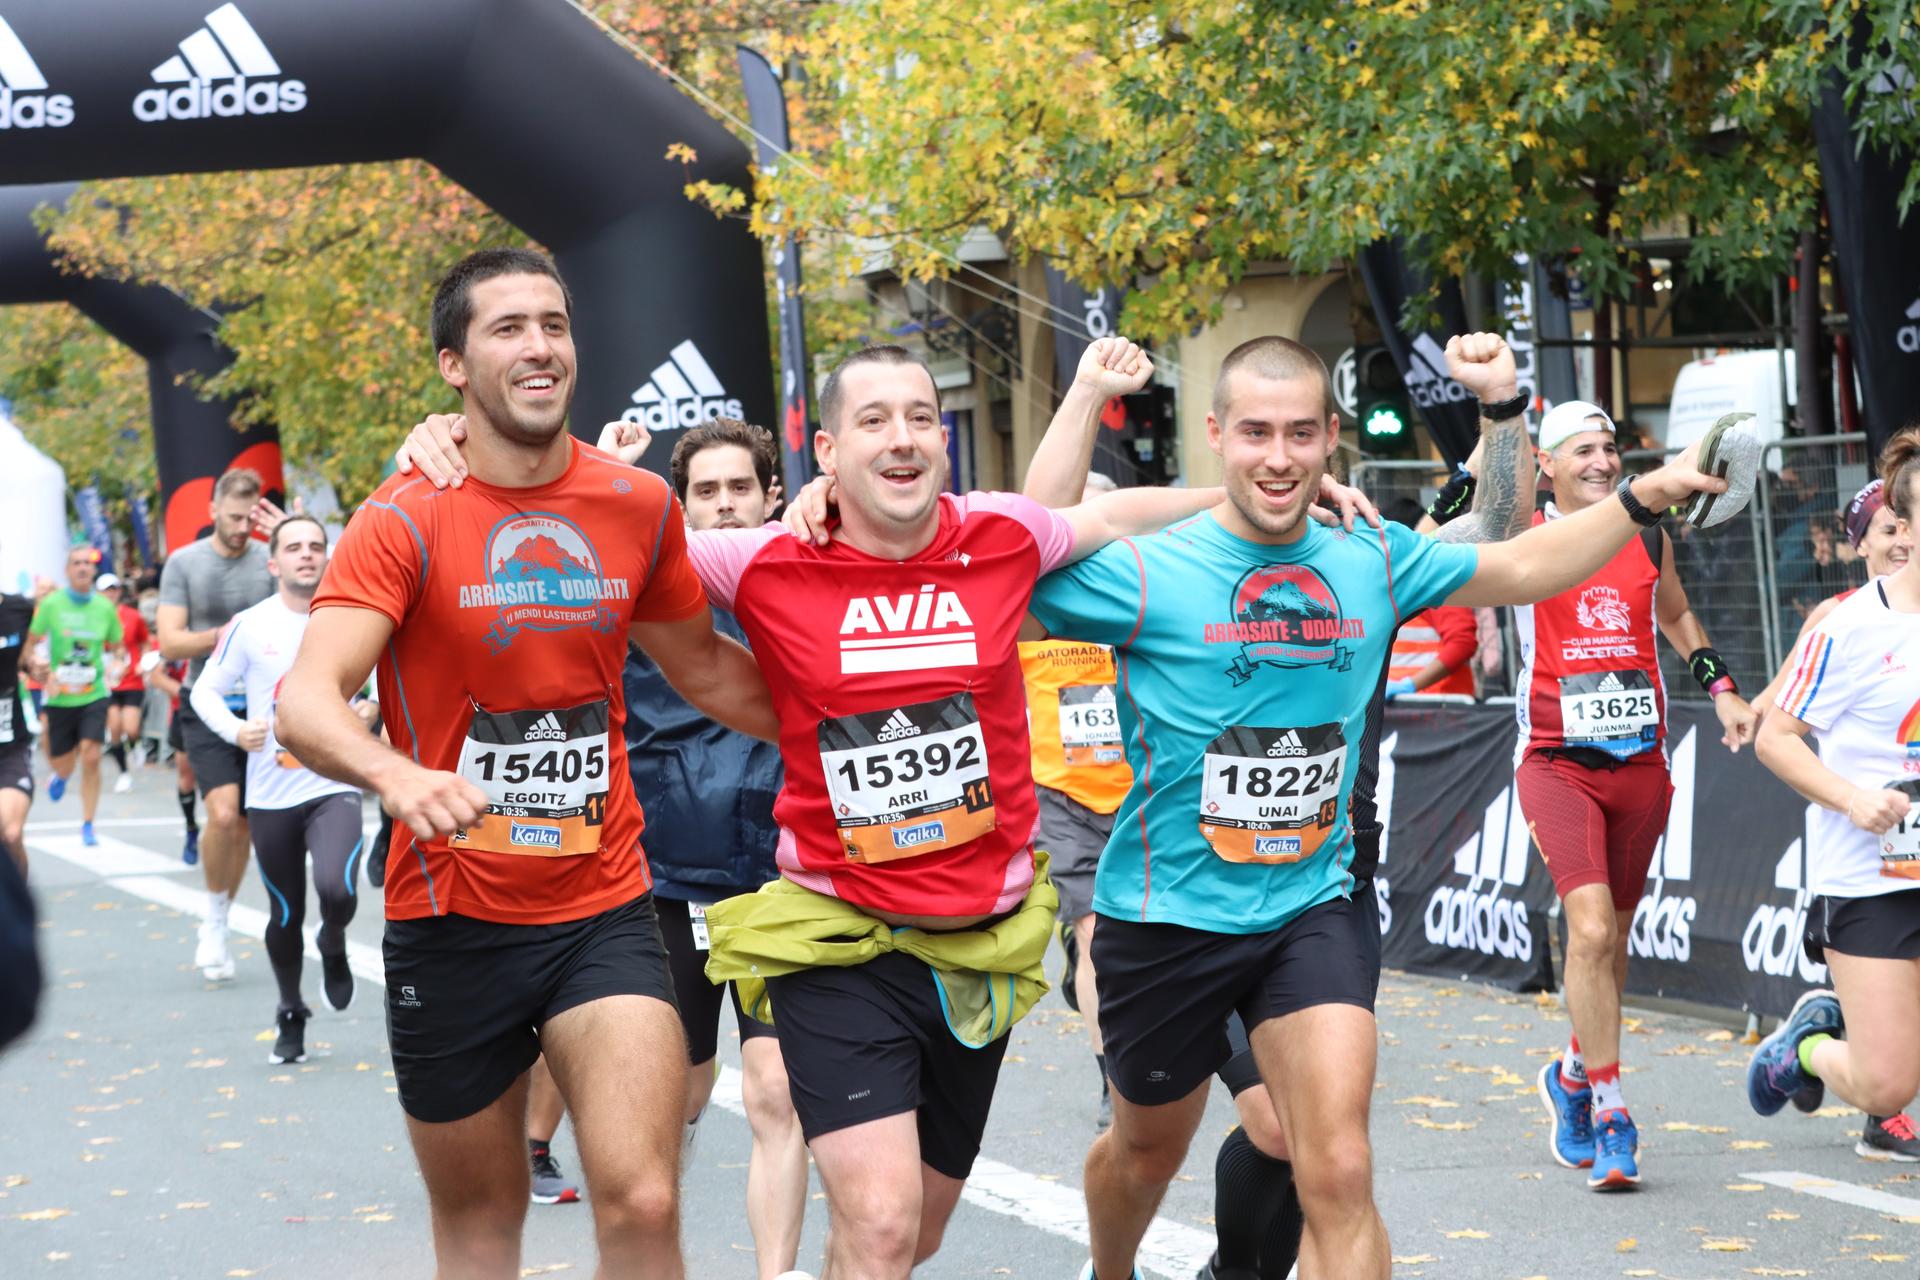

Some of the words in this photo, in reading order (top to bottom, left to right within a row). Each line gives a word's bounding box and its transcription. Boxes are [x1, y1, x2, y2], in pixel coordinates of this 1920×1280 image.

[132, 74, 307, 122] adidas
[621, 394, 744, 431] adidas
[459, 580, 548, 608] ARRASATE
[560, 578, 630, 601] UDALATX
[514, 608, 542, 621] MENDI
[543, 609, 597, 622] LASTERKETA
[1204, 620, 1290, 644] ARRASATE
[1301, 619, 1366, 641] UDALATX
[1037, 646, 1106, 659] GATORADE
[1052, 656, 1106, 667] RUNNING
[1572, 696, 1653, 720] 13625
[524, 729, 567, 741] adidas
[877, 725, 921, 742] adidas
[1590, 724, 1632, 734] JUANMA
[1267, 746, 1308, 757] adidas
[474, 744, 604, 784] 15405
[838, 735, 980, 792] 15392
[1219, 756, 1340, 798] 18224
[504, 792, 566, 806] EGOITZ
[888, 789, 929, 808] ARRI
[966, 781, 990, 807] 11
[502, 806, 529, 817] 10:35h
[878, 812, 906, 825] 10:35h
[1258, 806, 1298, 817] UNAI
[1320, 800, 1336, 822] 13
[1246, 822, 1272, 830] 10:47h
[515, 828, 558, 844] Kaiku
[898, 826, 939, 846] Kaiku
[1258, 839, 1298, 853] Kaiku
[1424, 874, 1532, 962] adidas
